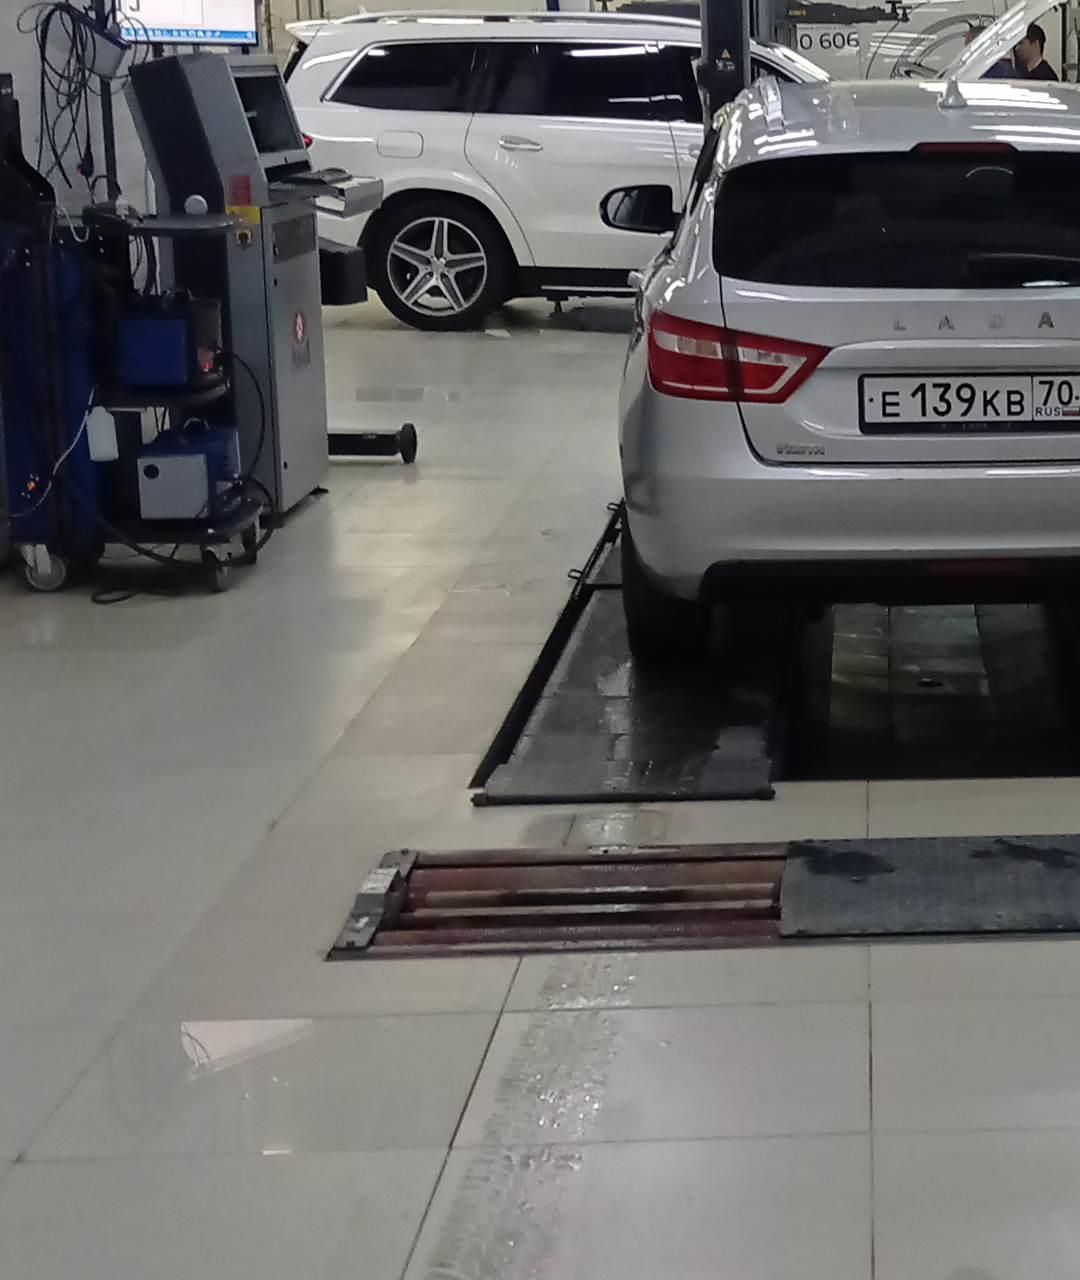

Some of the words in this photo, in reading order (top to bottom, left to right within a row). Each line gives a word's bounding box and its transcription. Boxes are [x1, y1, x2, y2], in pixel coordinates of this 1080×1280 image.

[820, 32, 859, 49] 606
[894, 312, 1055, 331] LADA
[1038, 380, 1074, 406] 70
[1035, 406, 1061, 417] RUS
